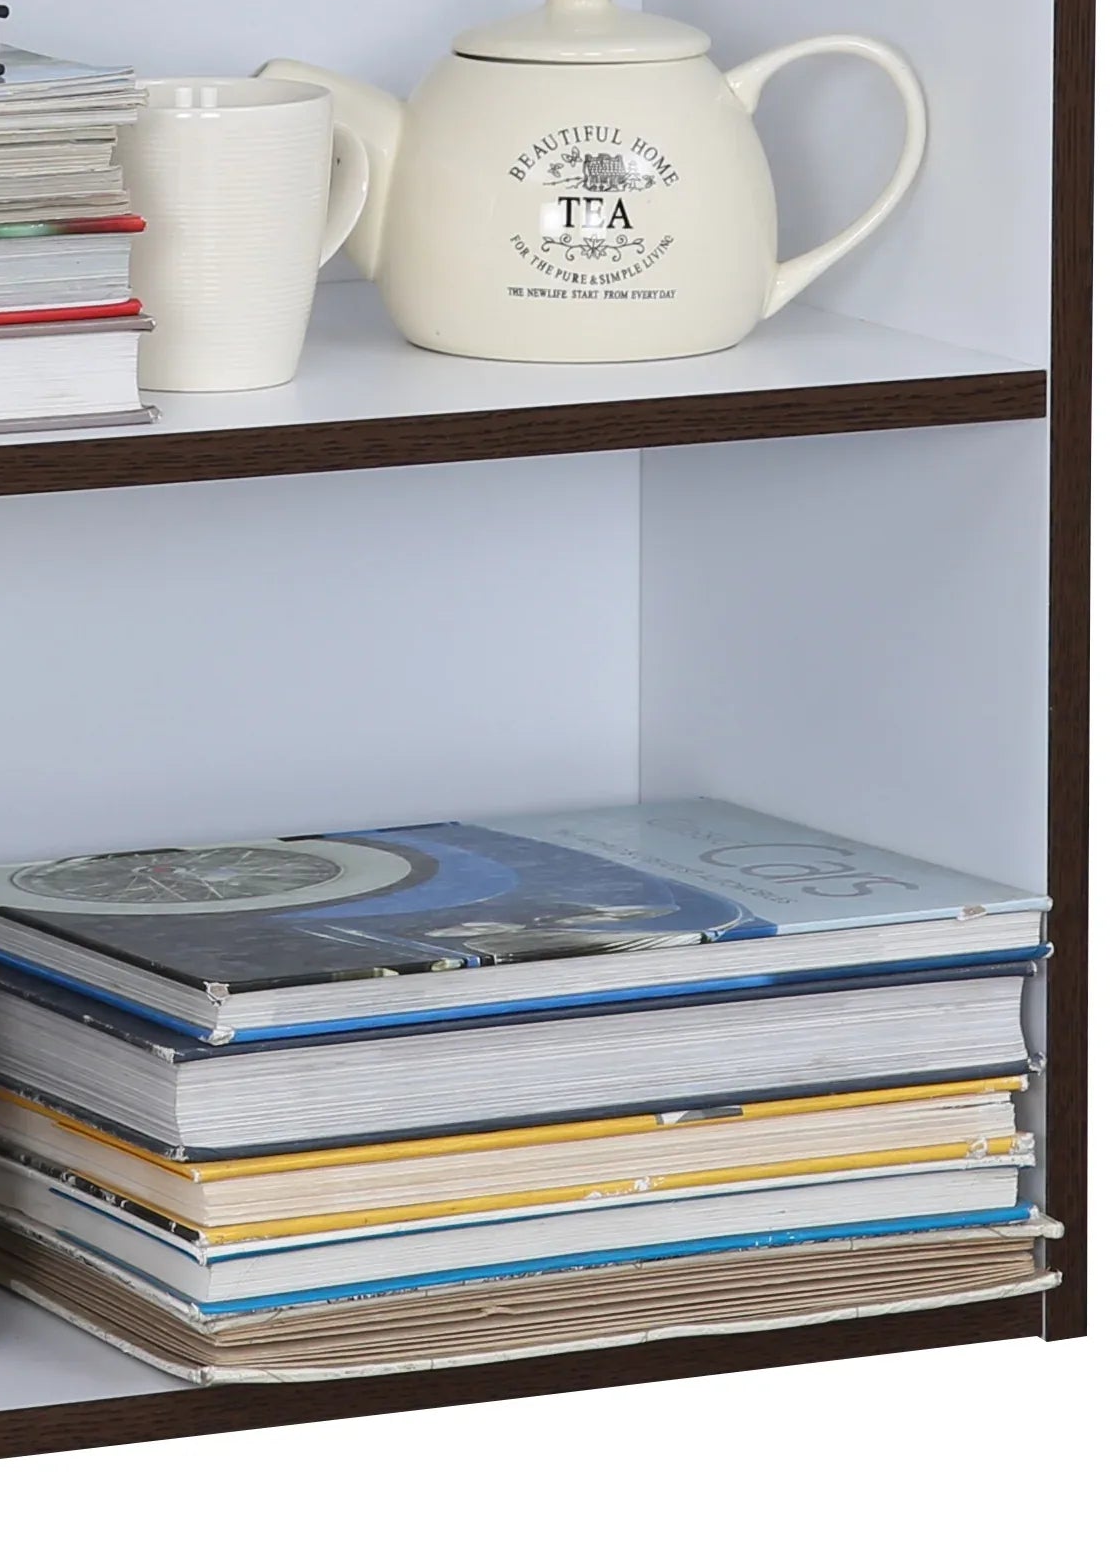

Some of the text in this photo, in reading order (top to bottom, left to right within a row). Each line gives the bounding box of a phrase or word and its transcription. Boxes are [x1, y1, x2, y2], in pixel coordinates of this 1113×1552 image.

[508, 124, 680, 187] BEAUTIFUL HOME
[557, 197, 634, 229] TEA
[510, 234, 529, 258] FOR
[530, 255, 555, 275] THE
[555, 268, 587, 285] PURE
[598, 263, 643, 285] SIMPLE
[642, 234, 674, 269] LIVING
[507, 287, 524, 298] THE
[571, 290, 599, 299] START
[603, 290, 629, 299] FROM
[699, 843, 919, 897] Cars
